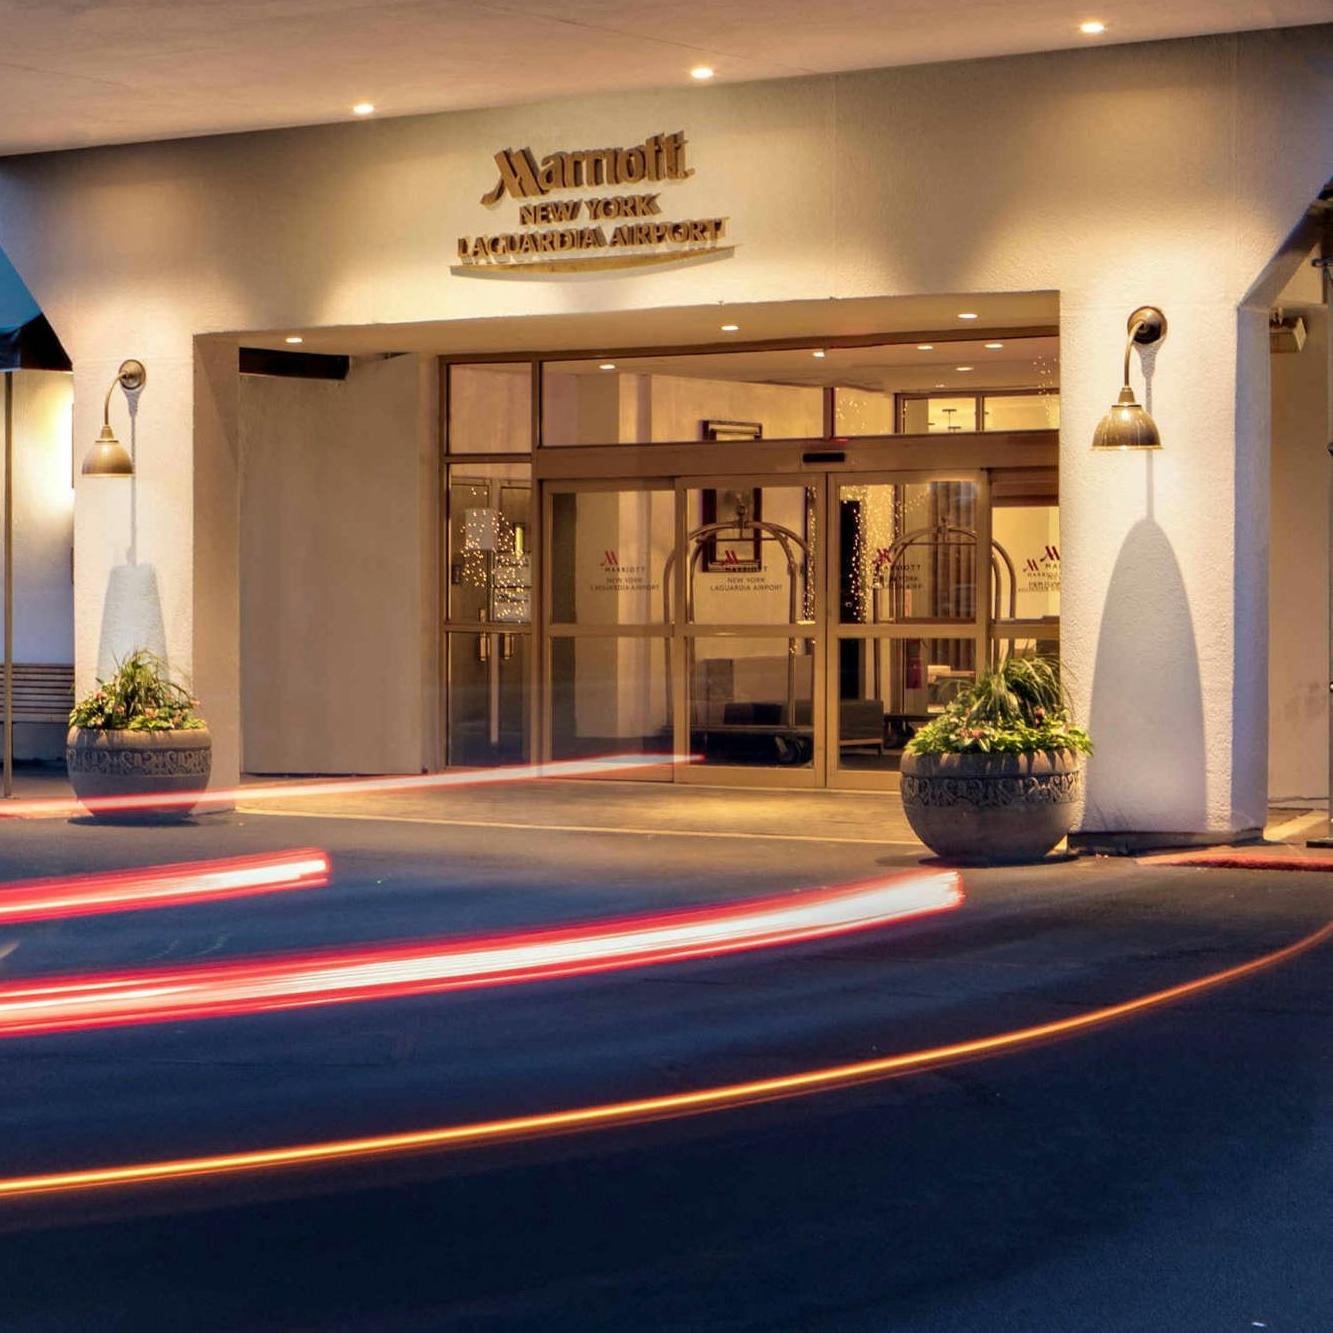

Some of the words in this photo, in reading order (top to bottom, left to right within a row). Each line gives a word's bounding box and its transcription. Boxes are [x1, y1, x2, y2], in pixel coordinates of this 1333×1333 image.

[480, 131, 695, 205] Marriott
[519, 197, 582, 226] NEW
[583, 192, 662, 221] YORK
[457, 225, 607, 258] LAGUARDIA
[608, 216, 731, 248] AIRPORT
[710, 584, 751, 592] LAGUARDIA
[753, 584, 783, 592] AIRPORT
